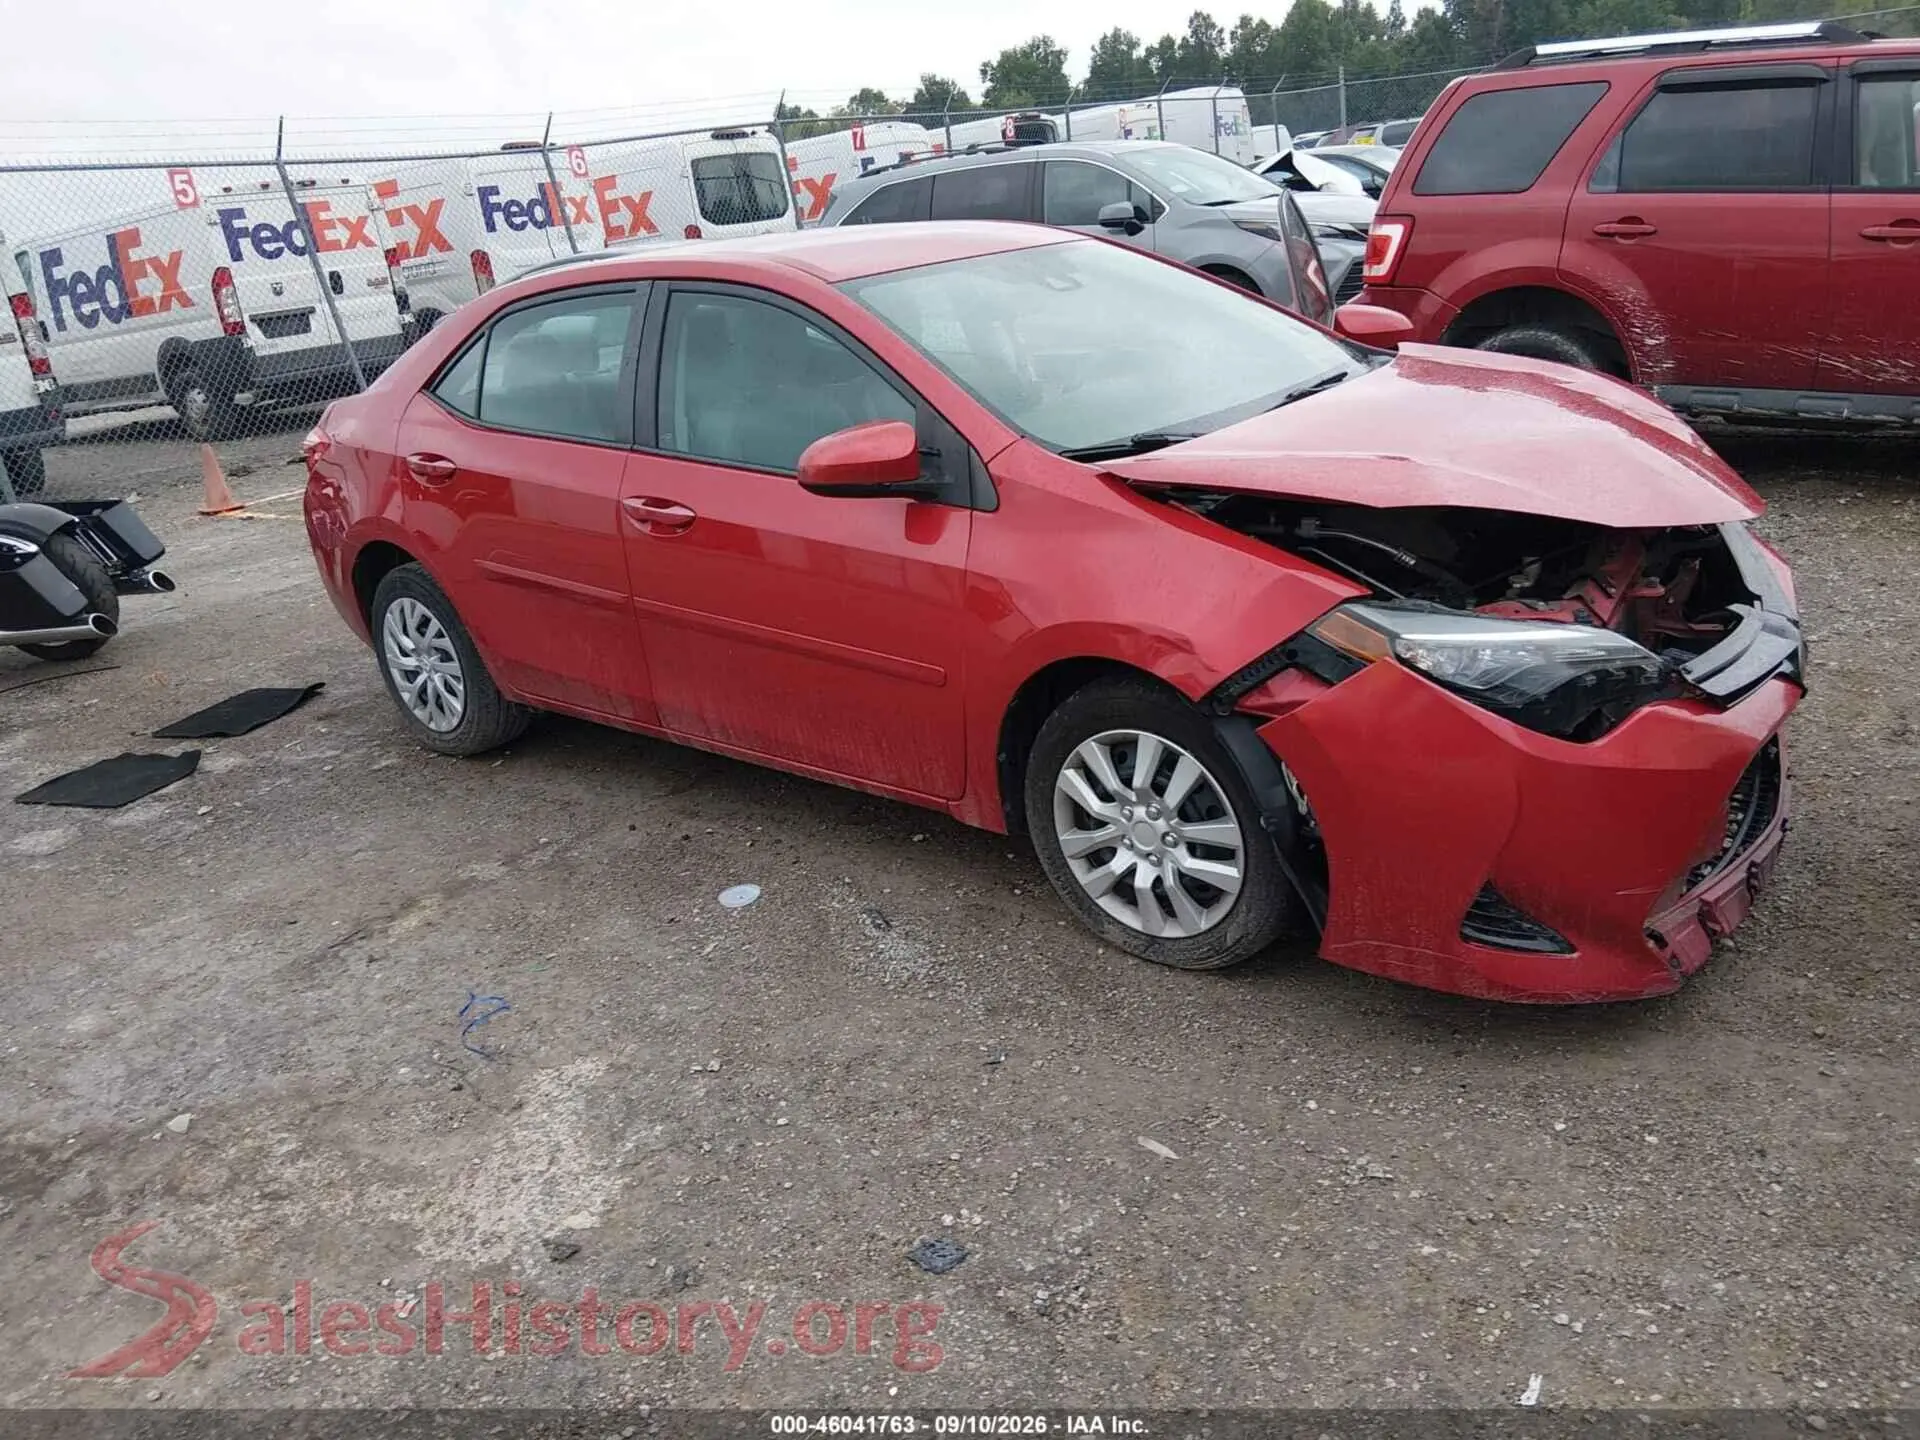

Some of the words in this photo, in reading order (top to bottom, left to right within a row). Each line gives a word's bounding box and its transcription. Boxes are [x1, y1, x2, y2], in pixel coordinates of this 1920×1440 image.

[852, 127, 863, 148] 7
[1005, 118, 1015, 138] 8
[571, 150, 587, 177] 6
[173, 174, 195, 205] 5
[477, 181, 594, 233] FedEx
[217, 200, 377, 263] FedEx
[40, 227, 195, 332] FedEx
